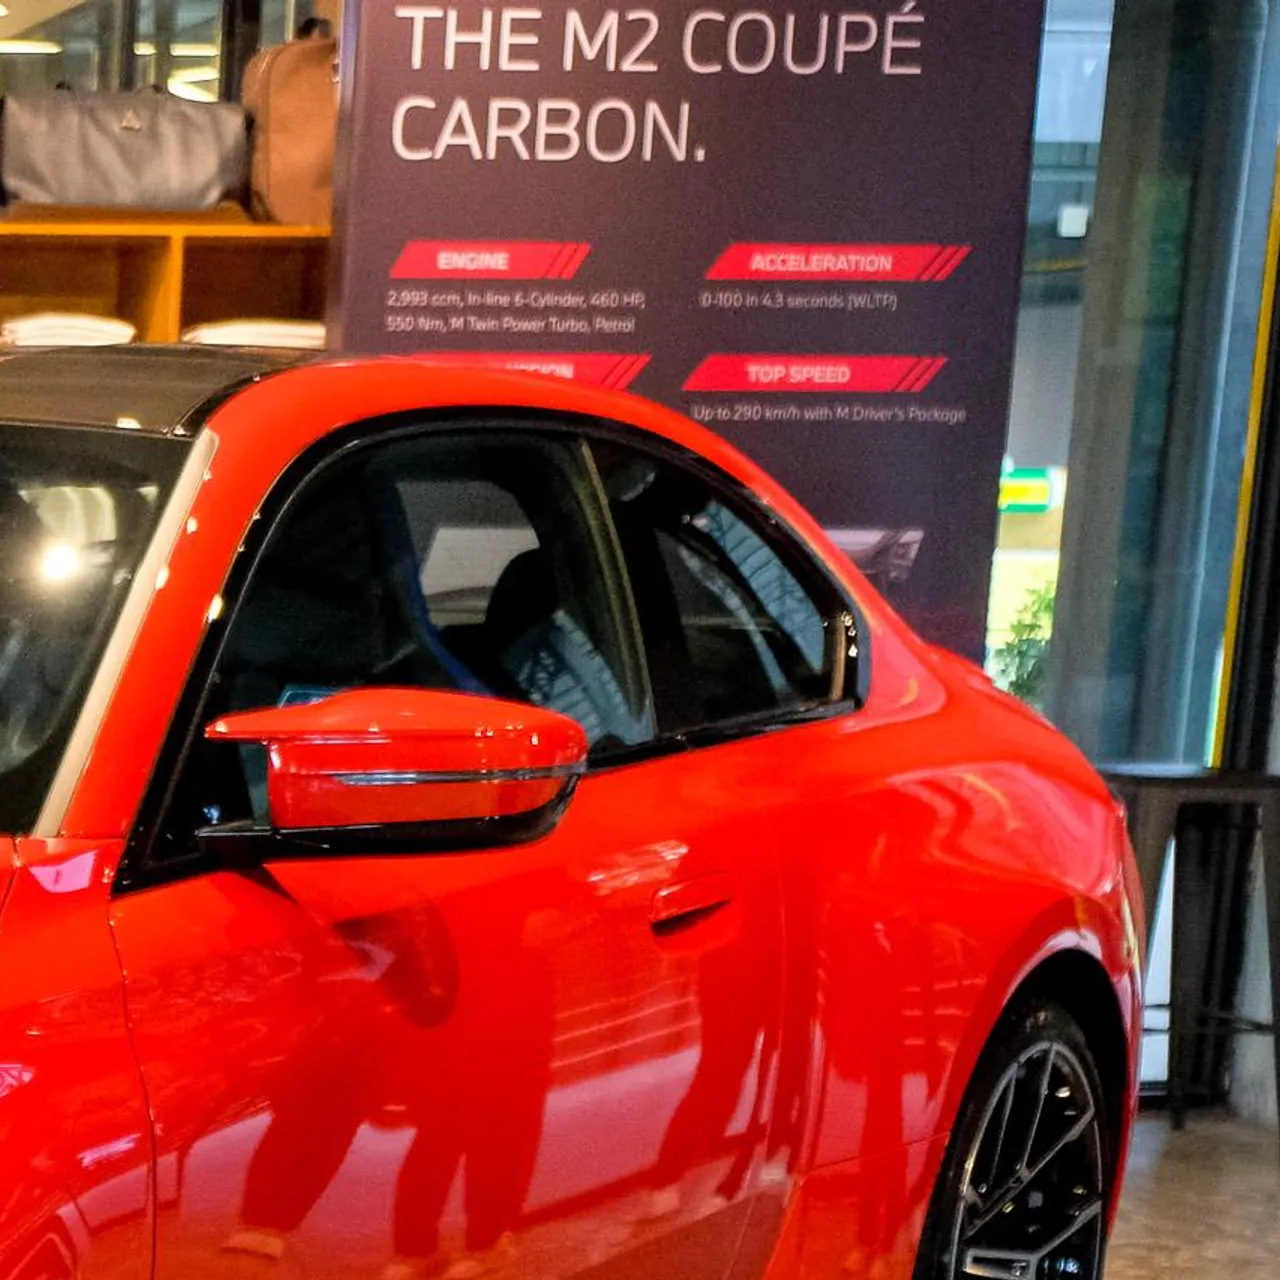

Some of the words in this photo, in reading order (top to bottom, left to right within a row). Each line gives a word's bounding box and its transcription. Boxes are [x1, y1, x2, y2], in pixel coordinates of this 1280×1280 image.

[393, 6, 542, 72] THE
[562, 9, 660, 73] M2
[682, 1, 926, 76] COUPÉ
[390, 96, 707, 163] CARBON.
[436, 251, 509, 271] ENGINE
[750, 252, 892, 273] ACCELERATION
[590, 291, 619, 307] 460
[701, 291, 742, 309] 0-100
[746, 292, 759, 309] in
[762, 292, 785, 309] 4.3
[787, 293, 845, 310] seconds
[847, 293, 899, 312] (WLTP)
[387, 316, 414, 331] 550
[450, 316, 464, 331] M
[468, 316, 500, 331] Twin
[502, 316, 545, 332] Power
[594, 316, 636, 333] Petrol
[747, 363, 786, 384] TOP
[789, 364, 850, 384] SPEED
[694, 405, 711, 422] Up
[717, 406, 731, 420] to
[734, 405, 762, 421] 290
[765, 404, 801, 421] km/h
[804, 405, 834, 421] with
[836, 406, 849, 420] M
[853, 405, 905, 421] Driver's
[908, 406, 966, 425] Package
